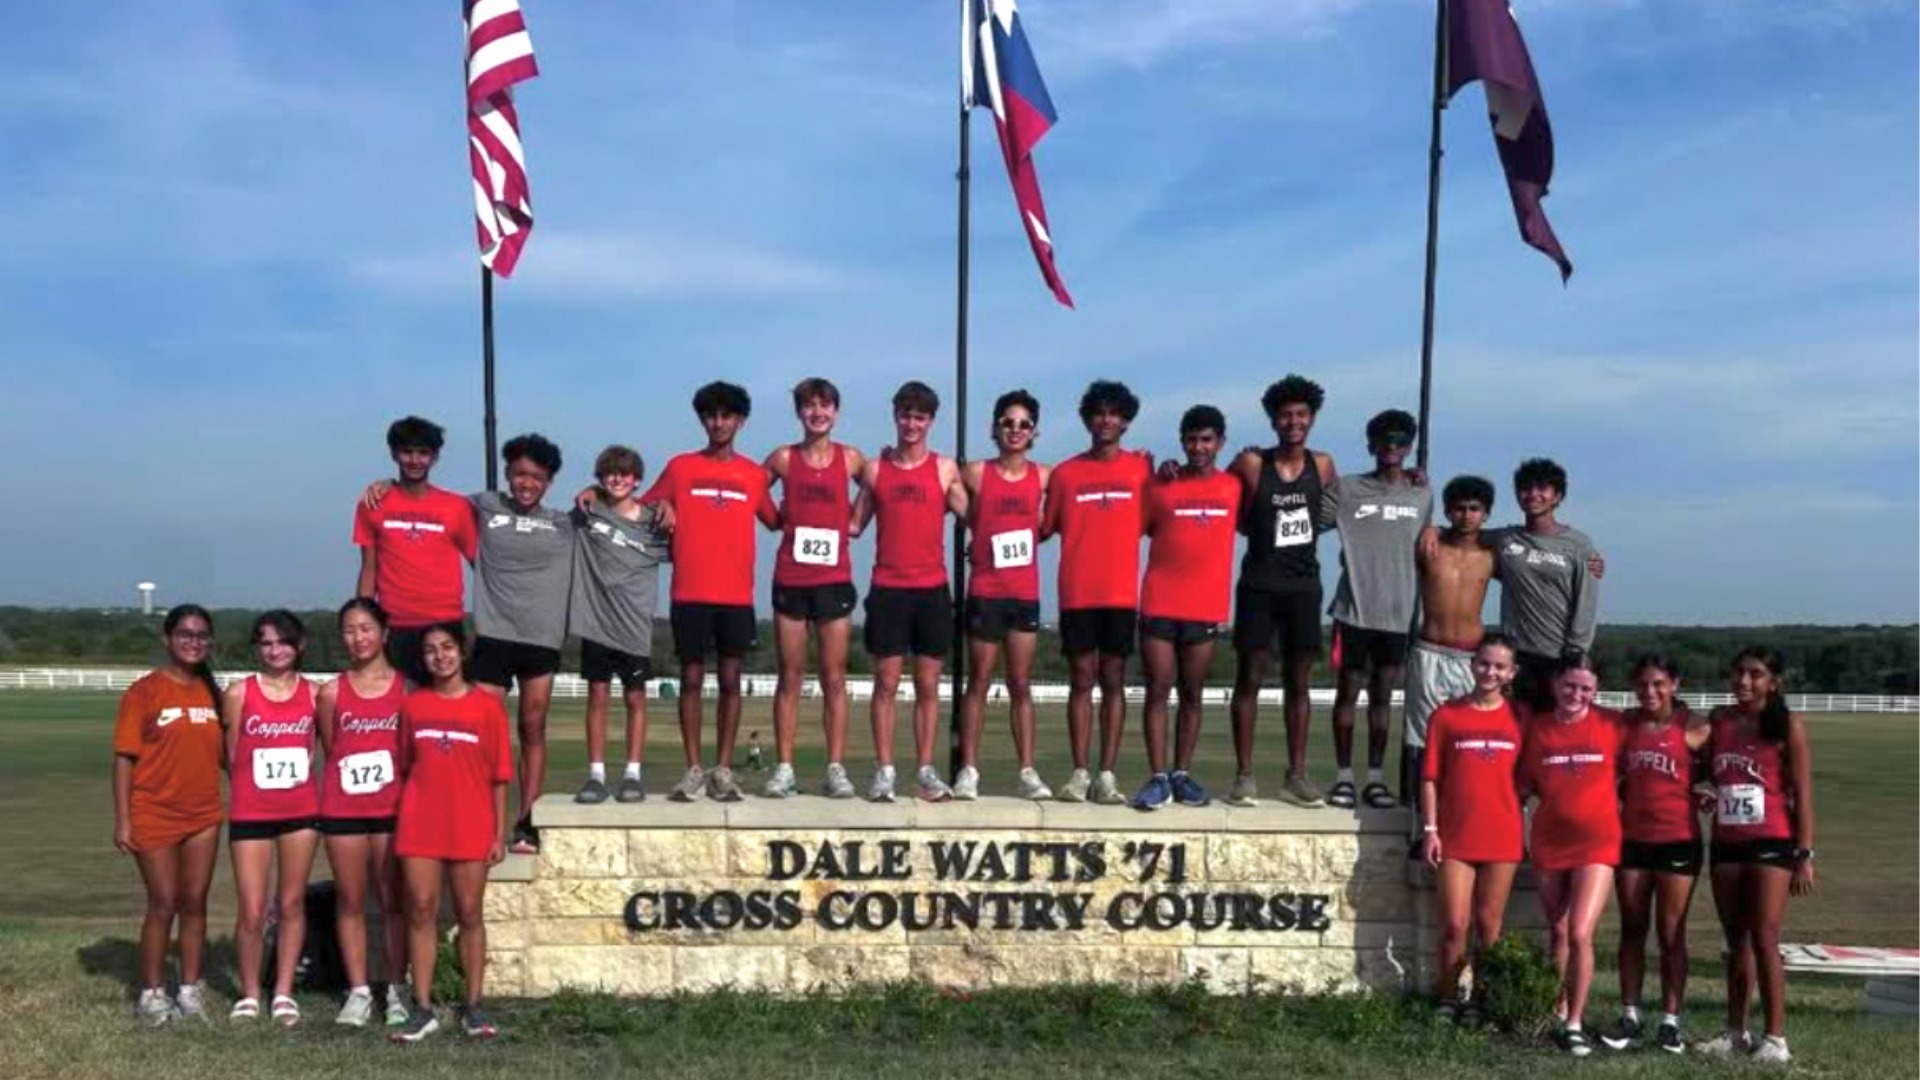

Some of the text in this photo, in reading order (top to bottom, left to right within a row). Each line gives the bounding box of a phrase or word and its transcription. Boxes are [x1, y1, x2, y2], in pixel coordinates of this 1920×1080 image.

[1281, 519, 1309, 538] 820
[802, 539, 831, 557] 823
[1002, 542, 1028, 560] 818
[245, 714, 312, 739] Coppell
[265, 762, 298, 780] 171
[350, 764, 384, 786] 172
[1723, 797, 1754, 816] 175
[767, 840, 1186, 882] DALE WATTS '71
[623, 890, 1330, 931] CROSS COUNTRY COURSE
